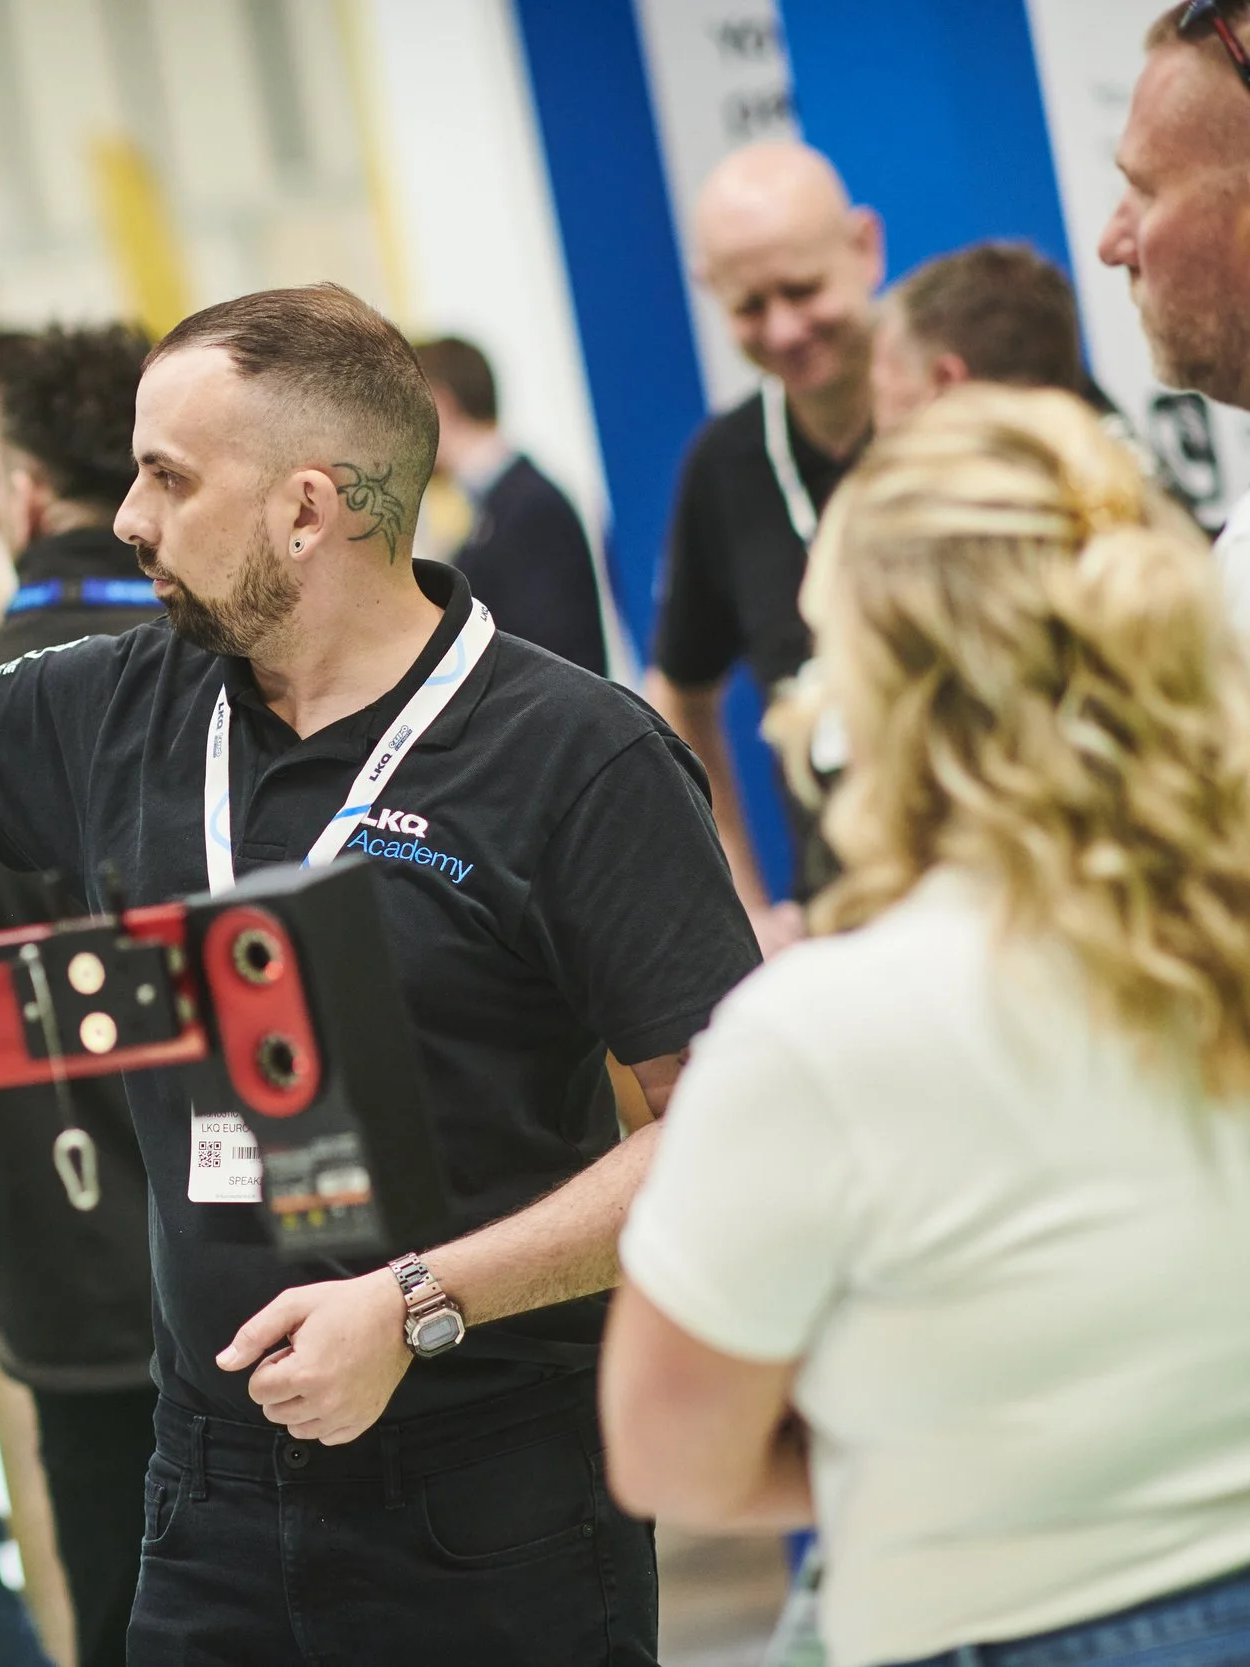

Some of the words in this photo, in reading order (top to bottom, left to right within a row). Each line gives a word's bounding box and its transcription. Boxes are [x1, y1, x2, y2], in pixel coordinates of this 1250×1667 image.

[216, 702, 225, 731] LKQ
[369, 753, 393, 782] LKQ
[360, 807, 429, 839] LKQ
[347, 829, 474, 884] Academy
[201, 1123, 220, 1133] LKQ
[222, 1123, 250, 1133] EURO
[228, 1176, 262, 1186] SPEAK
